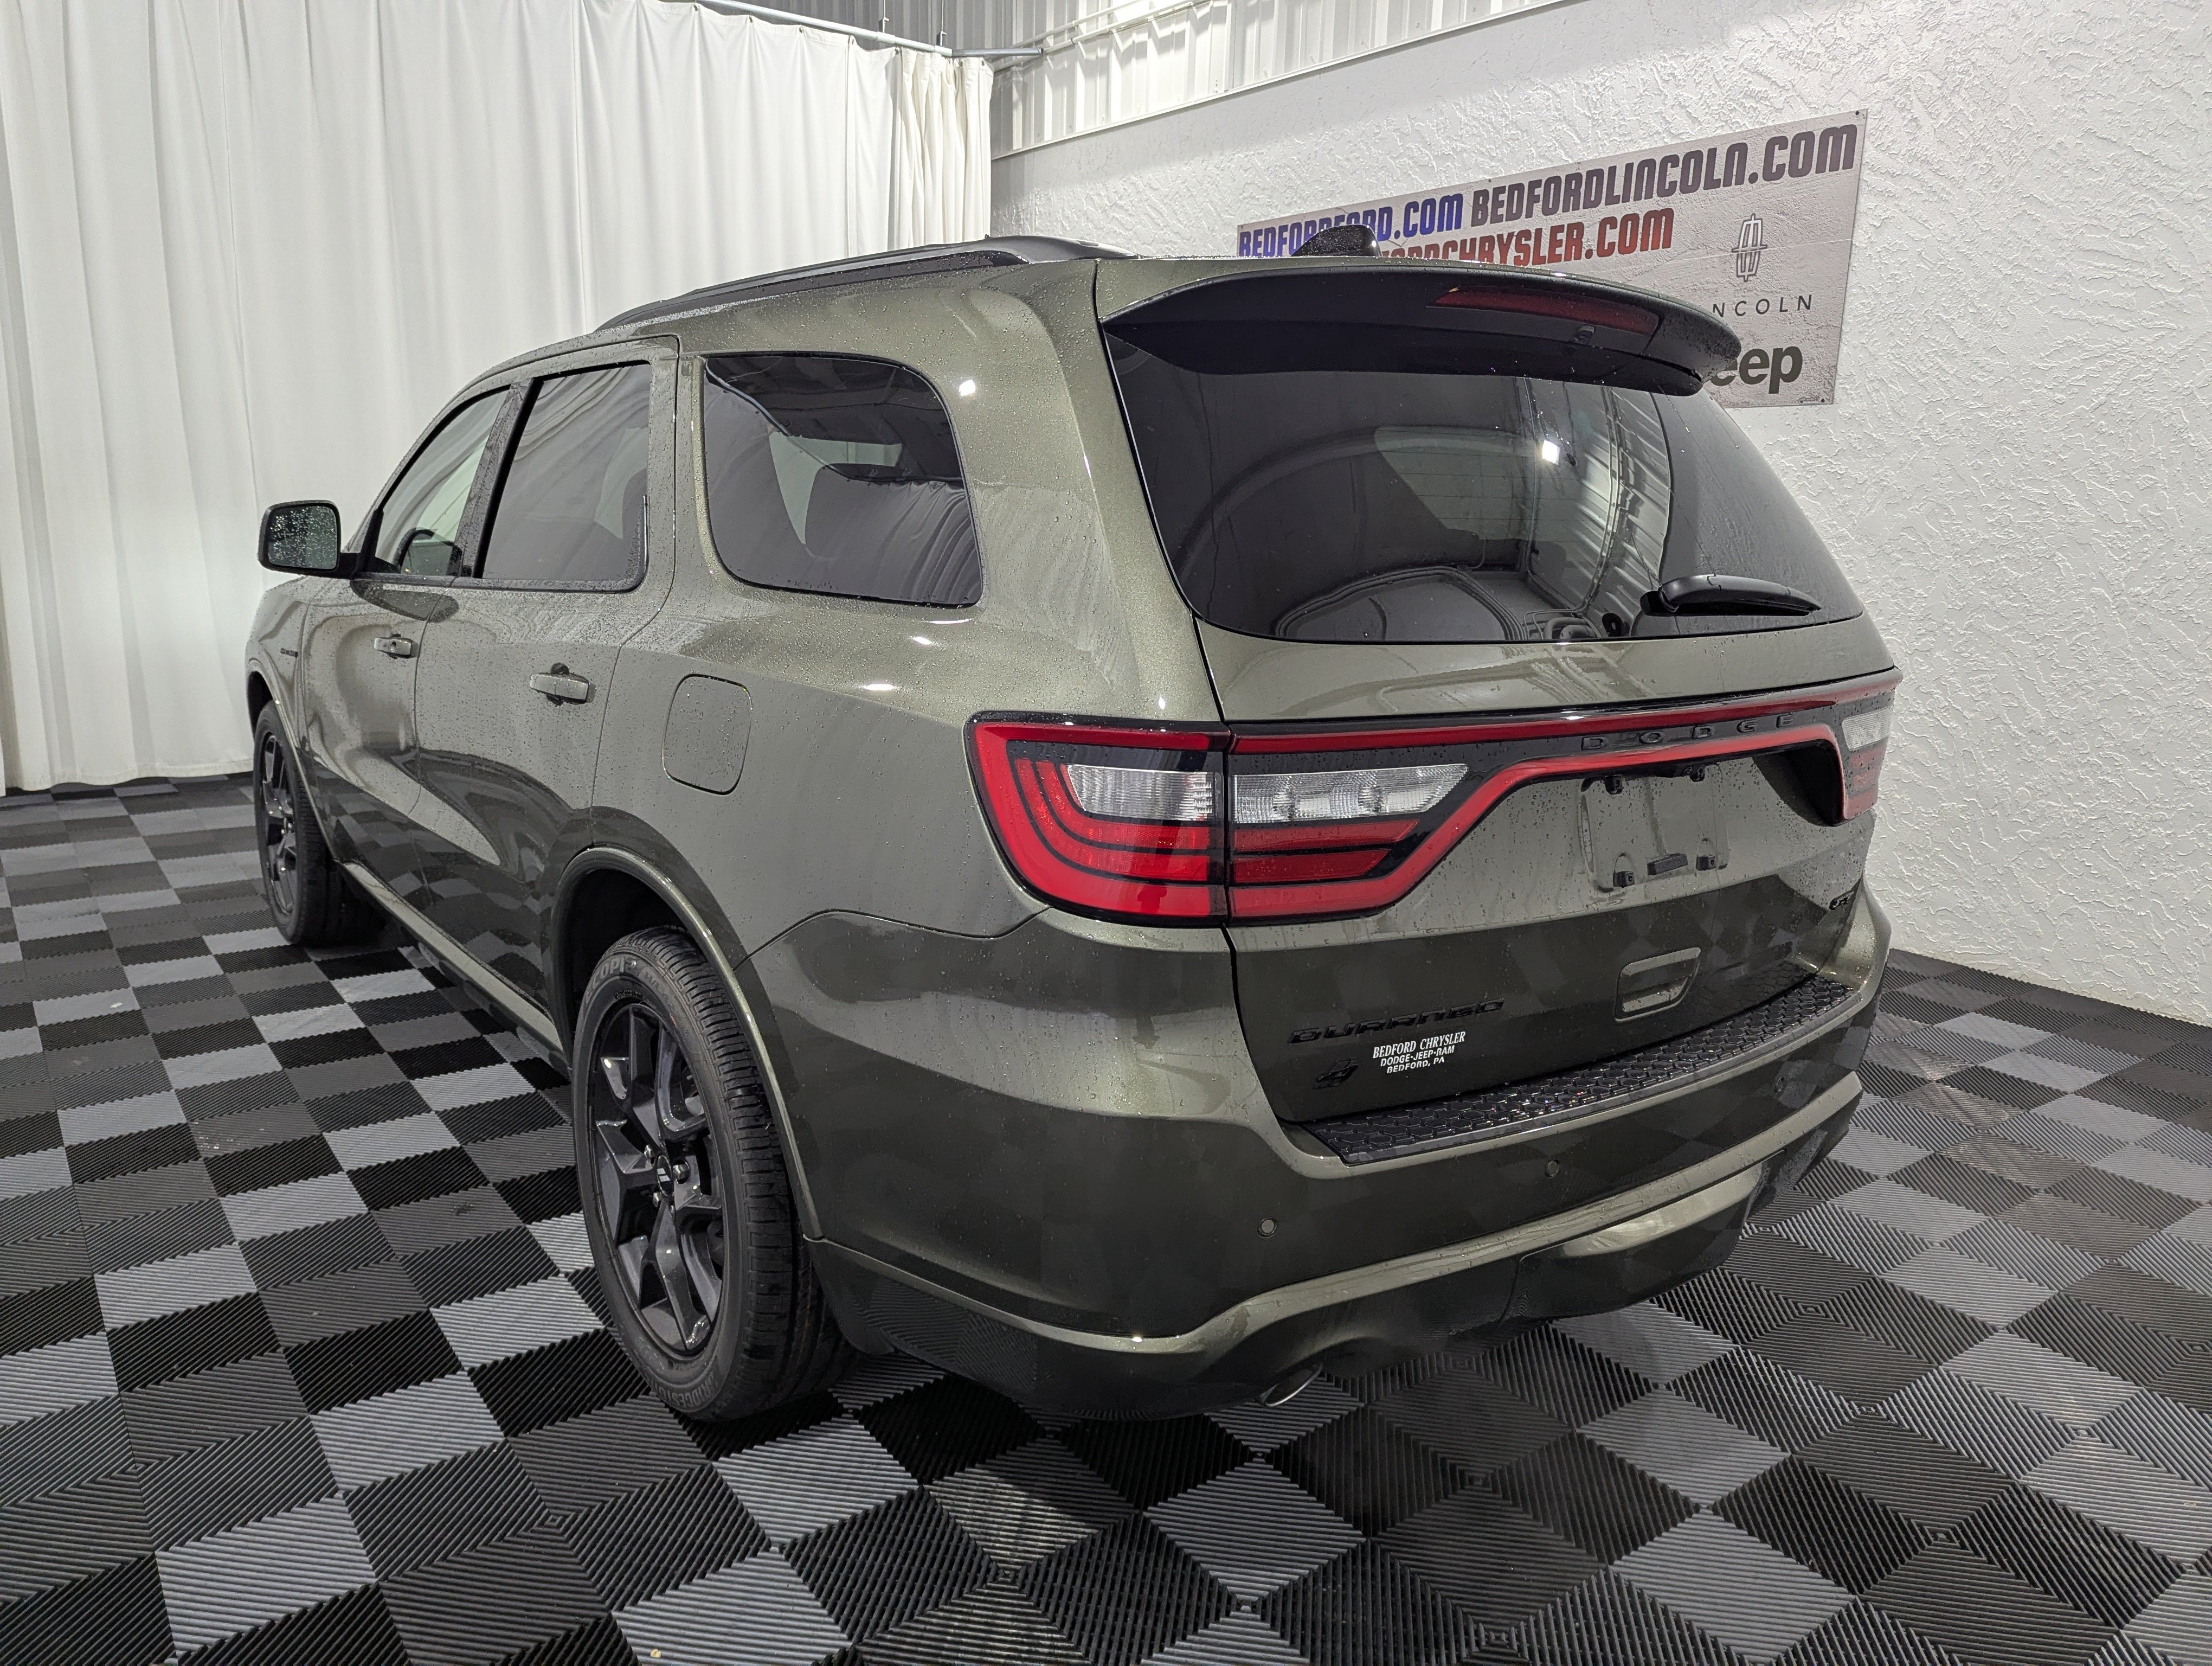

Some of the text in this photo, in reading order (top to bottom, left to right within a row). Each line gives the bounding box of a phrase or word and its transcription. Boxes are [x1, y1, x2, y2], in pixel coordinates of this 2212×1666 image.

[1471, 124, 1857, 227] BEDFORDLINCOLN.COM
[1712, 294, 1812, 318] NCOLN
[1581, 713, 1793, 751] DODGE
[1288, 997, 1504, 1044] DURANGO
[1372, 1031, 1466, 1059] BEDFORD CHRYSLER
[1386, 1056, 1445, 1074] BEDFORD, PA
